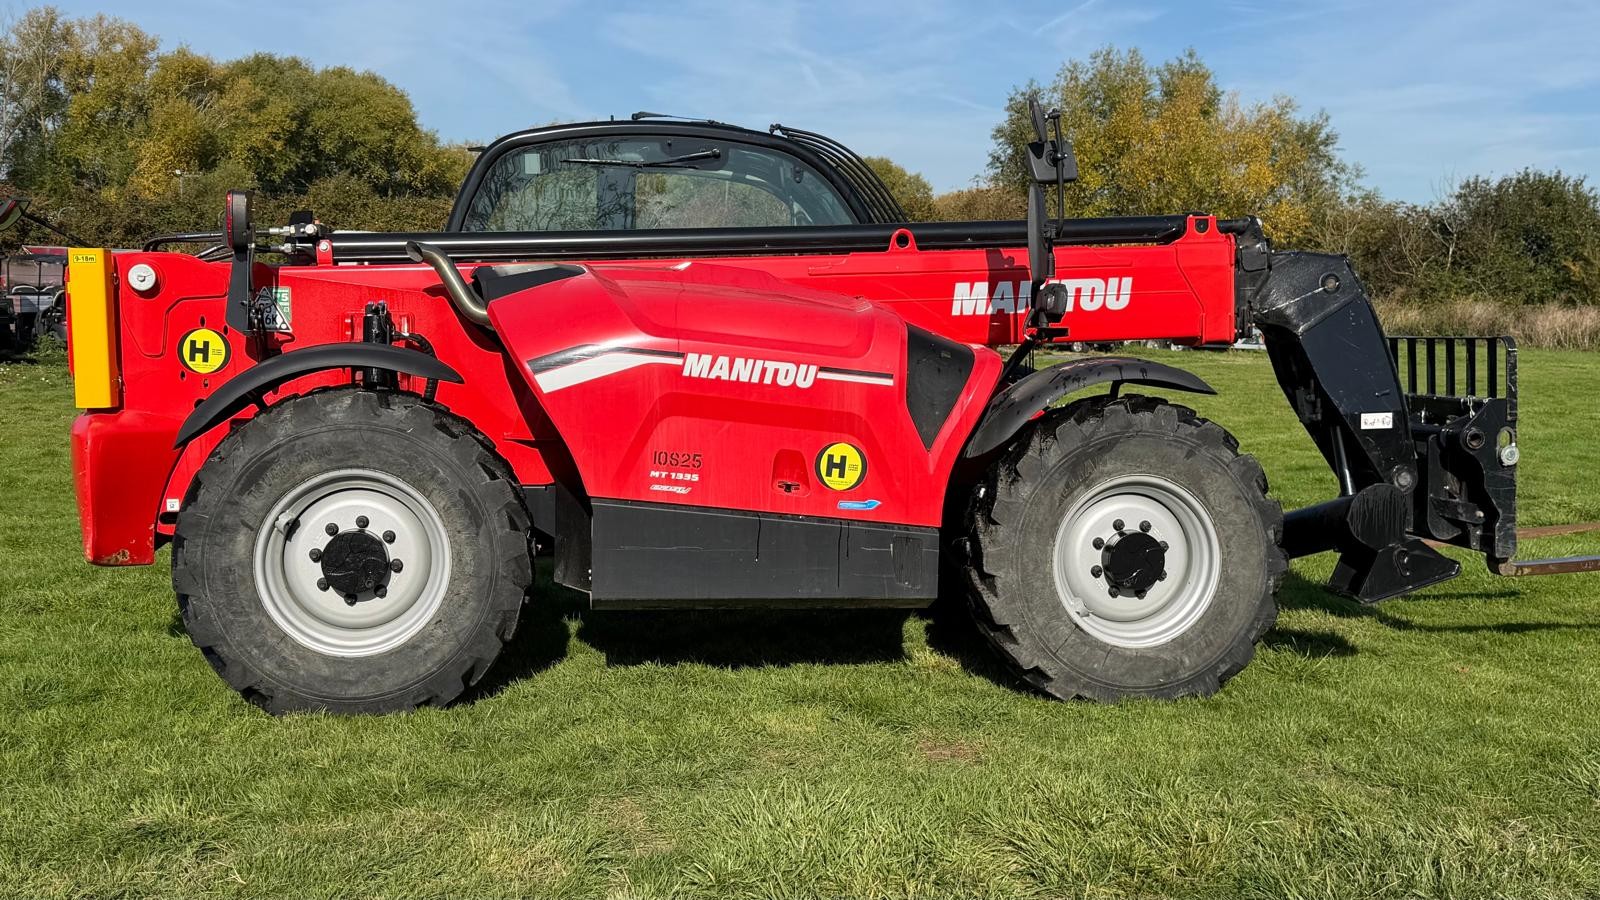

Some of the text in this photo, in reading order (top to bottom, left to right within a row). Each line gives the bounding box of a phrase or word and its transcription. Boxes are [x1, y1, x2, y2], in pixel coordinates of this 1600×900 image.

[189, 340, 209, 363] H
[682, 352, 818, 389] MANITOU
[650, 470, 668, 478] MT
[826, 454, 847, 478] H
